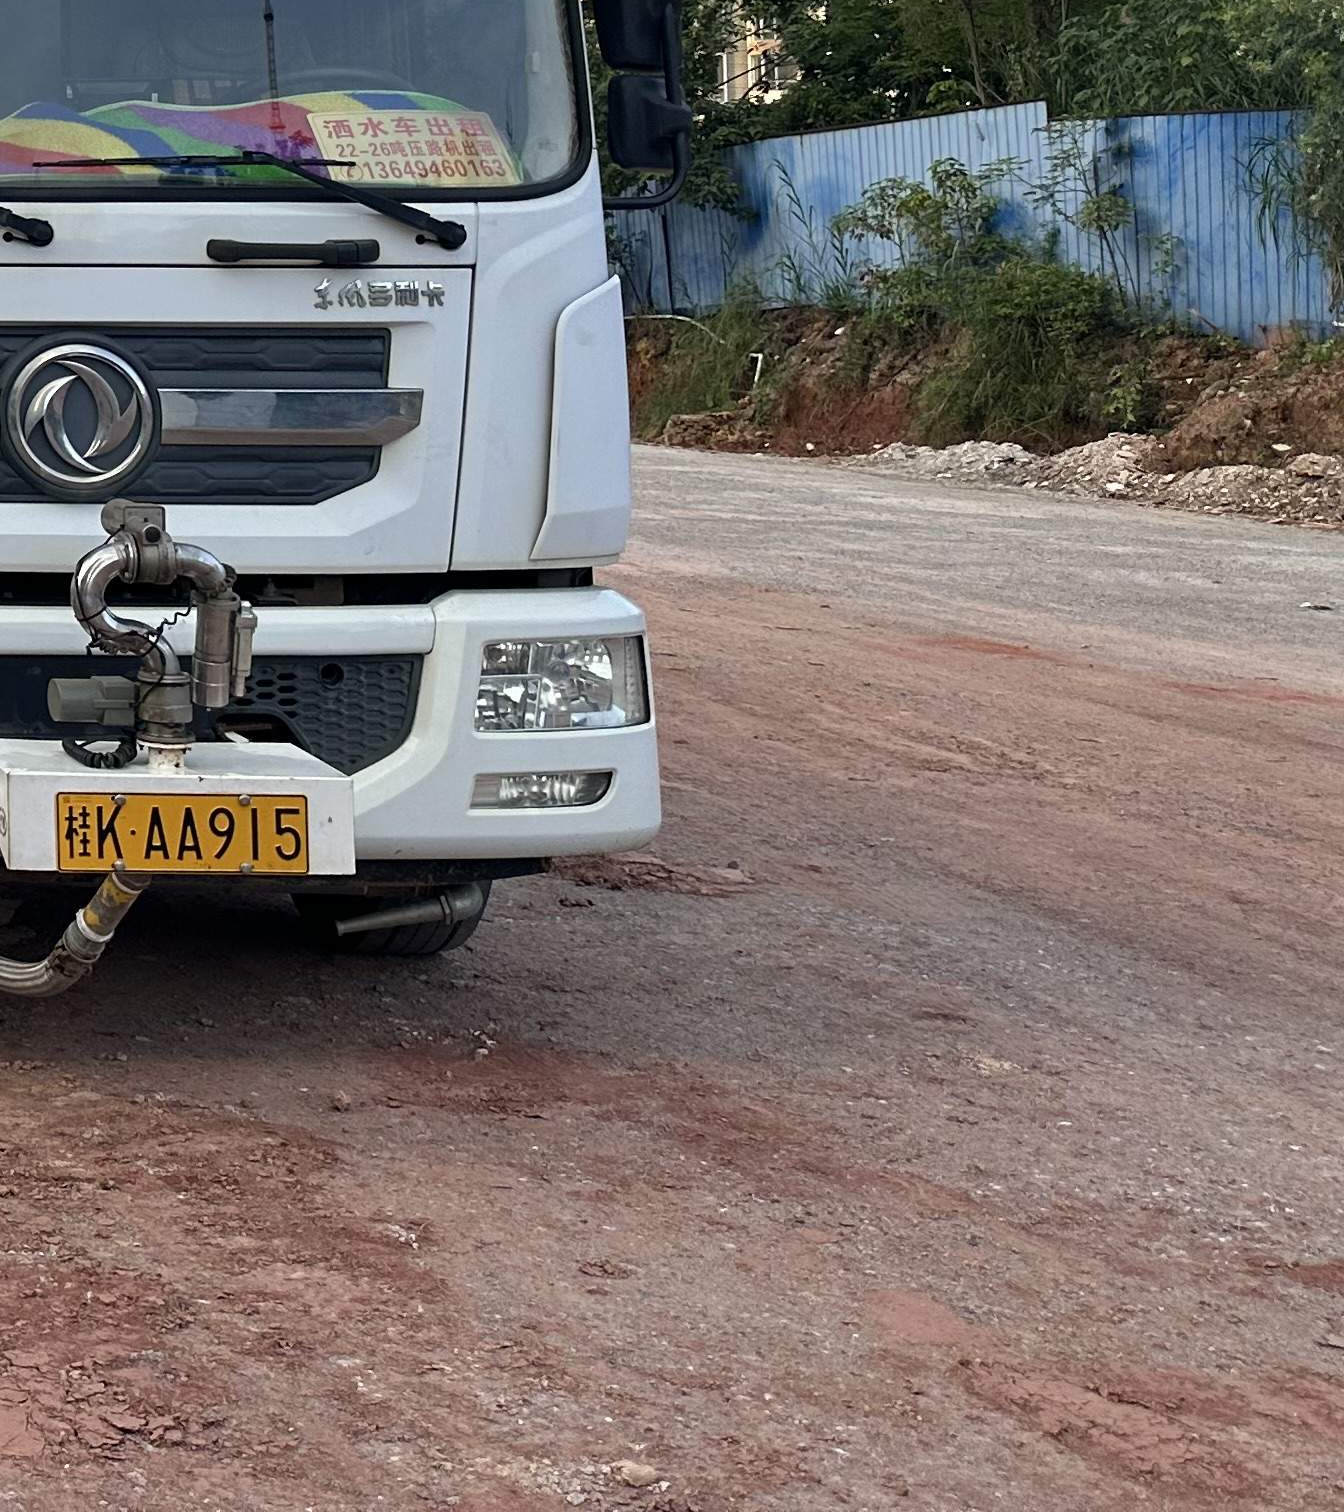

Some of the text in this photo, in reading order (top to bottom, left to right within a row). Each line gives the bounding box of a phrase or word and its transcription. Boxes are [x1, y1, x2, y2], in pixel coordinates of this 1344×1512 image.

[323, 117, 489, 139] 洒水车出租
[336, 140, 497, 158] 22-26吨压路机出租
[363, 160, 506, 179] 13649460163
[65, 806, 302, 861] 桂K·AA915
